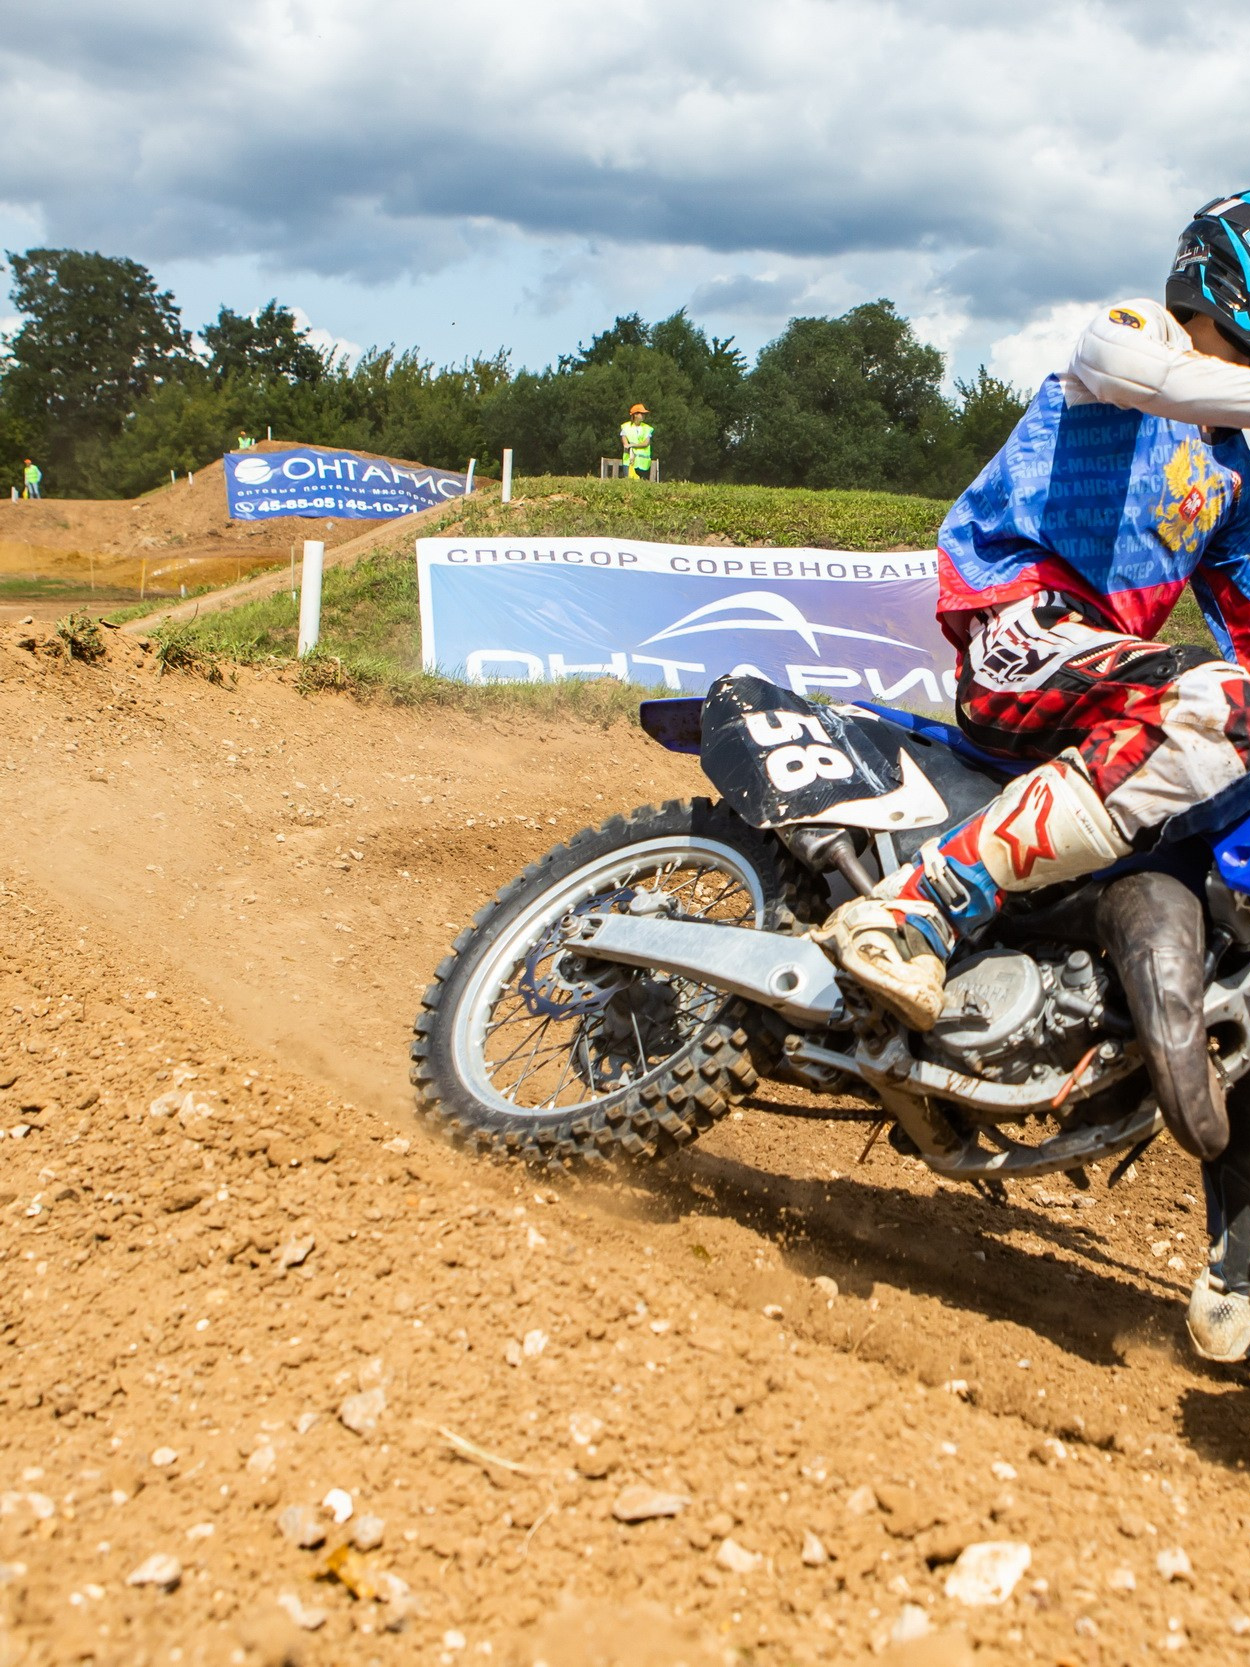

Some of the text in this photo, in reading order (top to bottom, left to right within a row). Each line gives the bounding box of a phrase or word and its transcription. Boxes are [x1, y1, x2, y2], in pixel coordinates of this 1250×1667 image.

[345, 499, 418, 513] 45-10-71
[447, 549, 638, 567] СПОНСОР
[741, 708, 855, 793] 58
